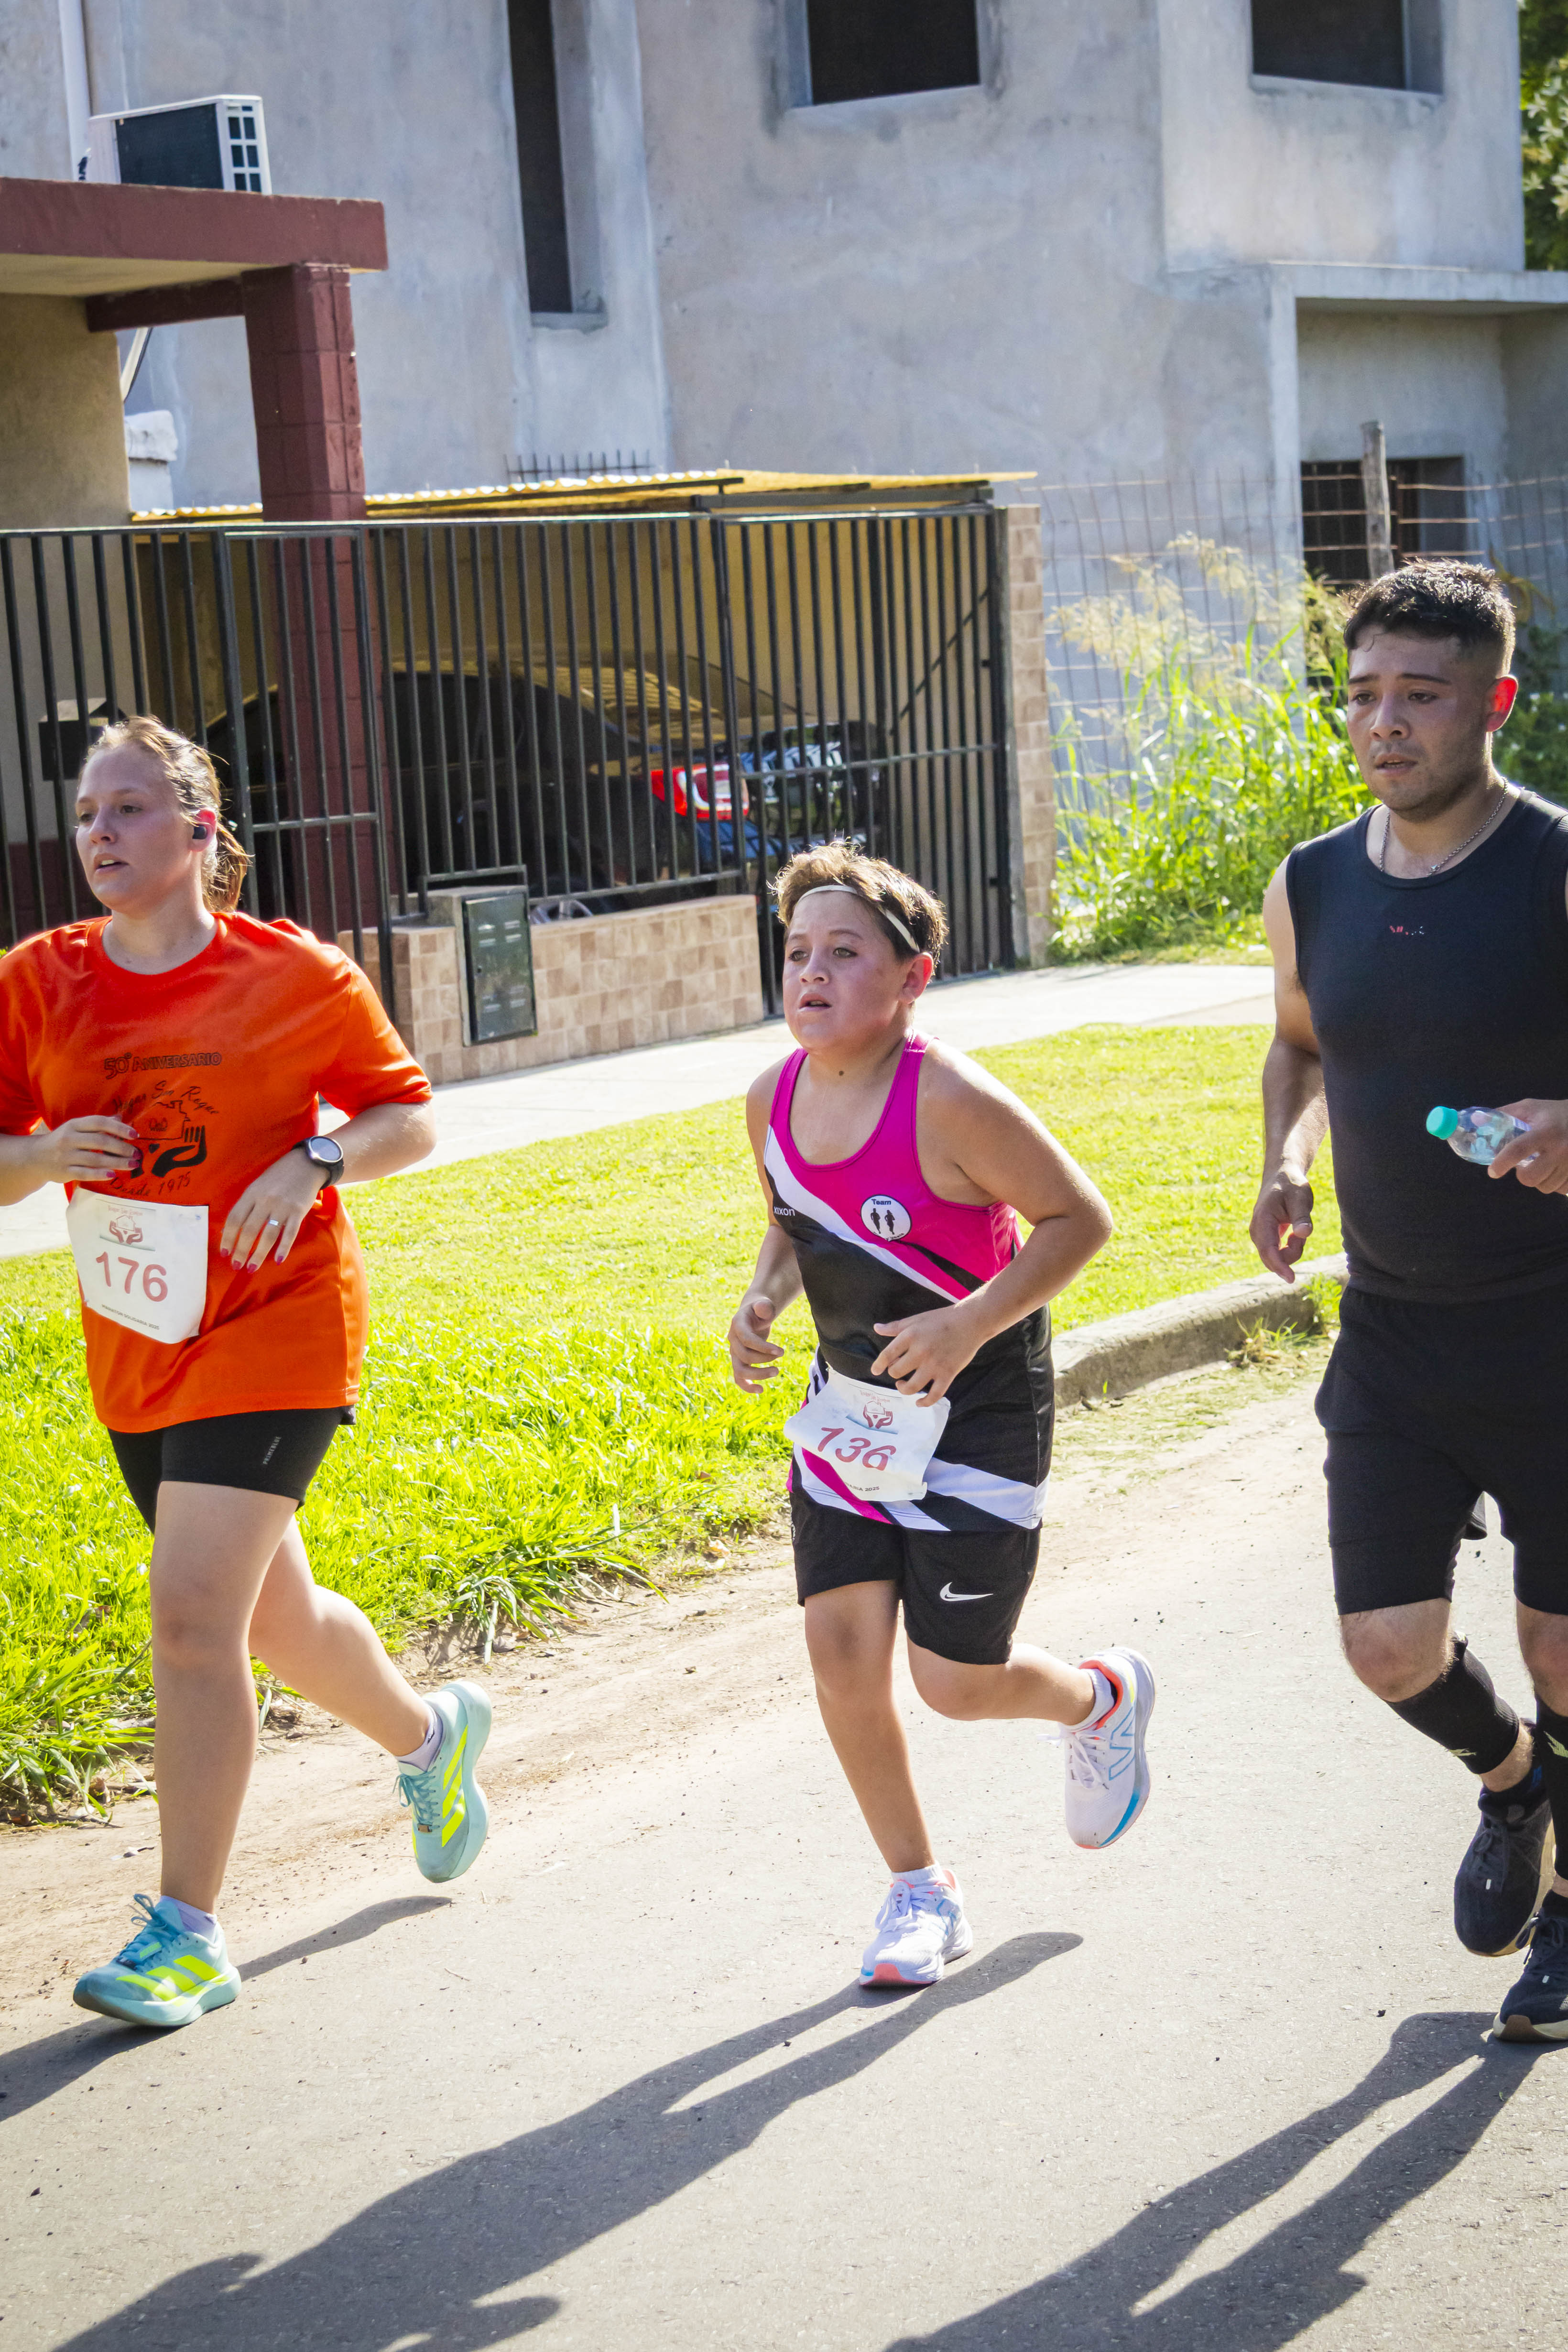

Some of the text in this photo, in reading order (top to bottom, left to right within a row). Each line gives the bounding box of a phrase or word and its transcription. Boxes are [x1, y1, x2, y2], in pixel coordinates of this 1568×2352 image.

[132, 1052, 222, 1072] ANIVERSARIO
[159, 1171, 191, 1195] 1975
[96, 1252, 168, 1302] 176
[817, 1427, 897, 1471] 136
